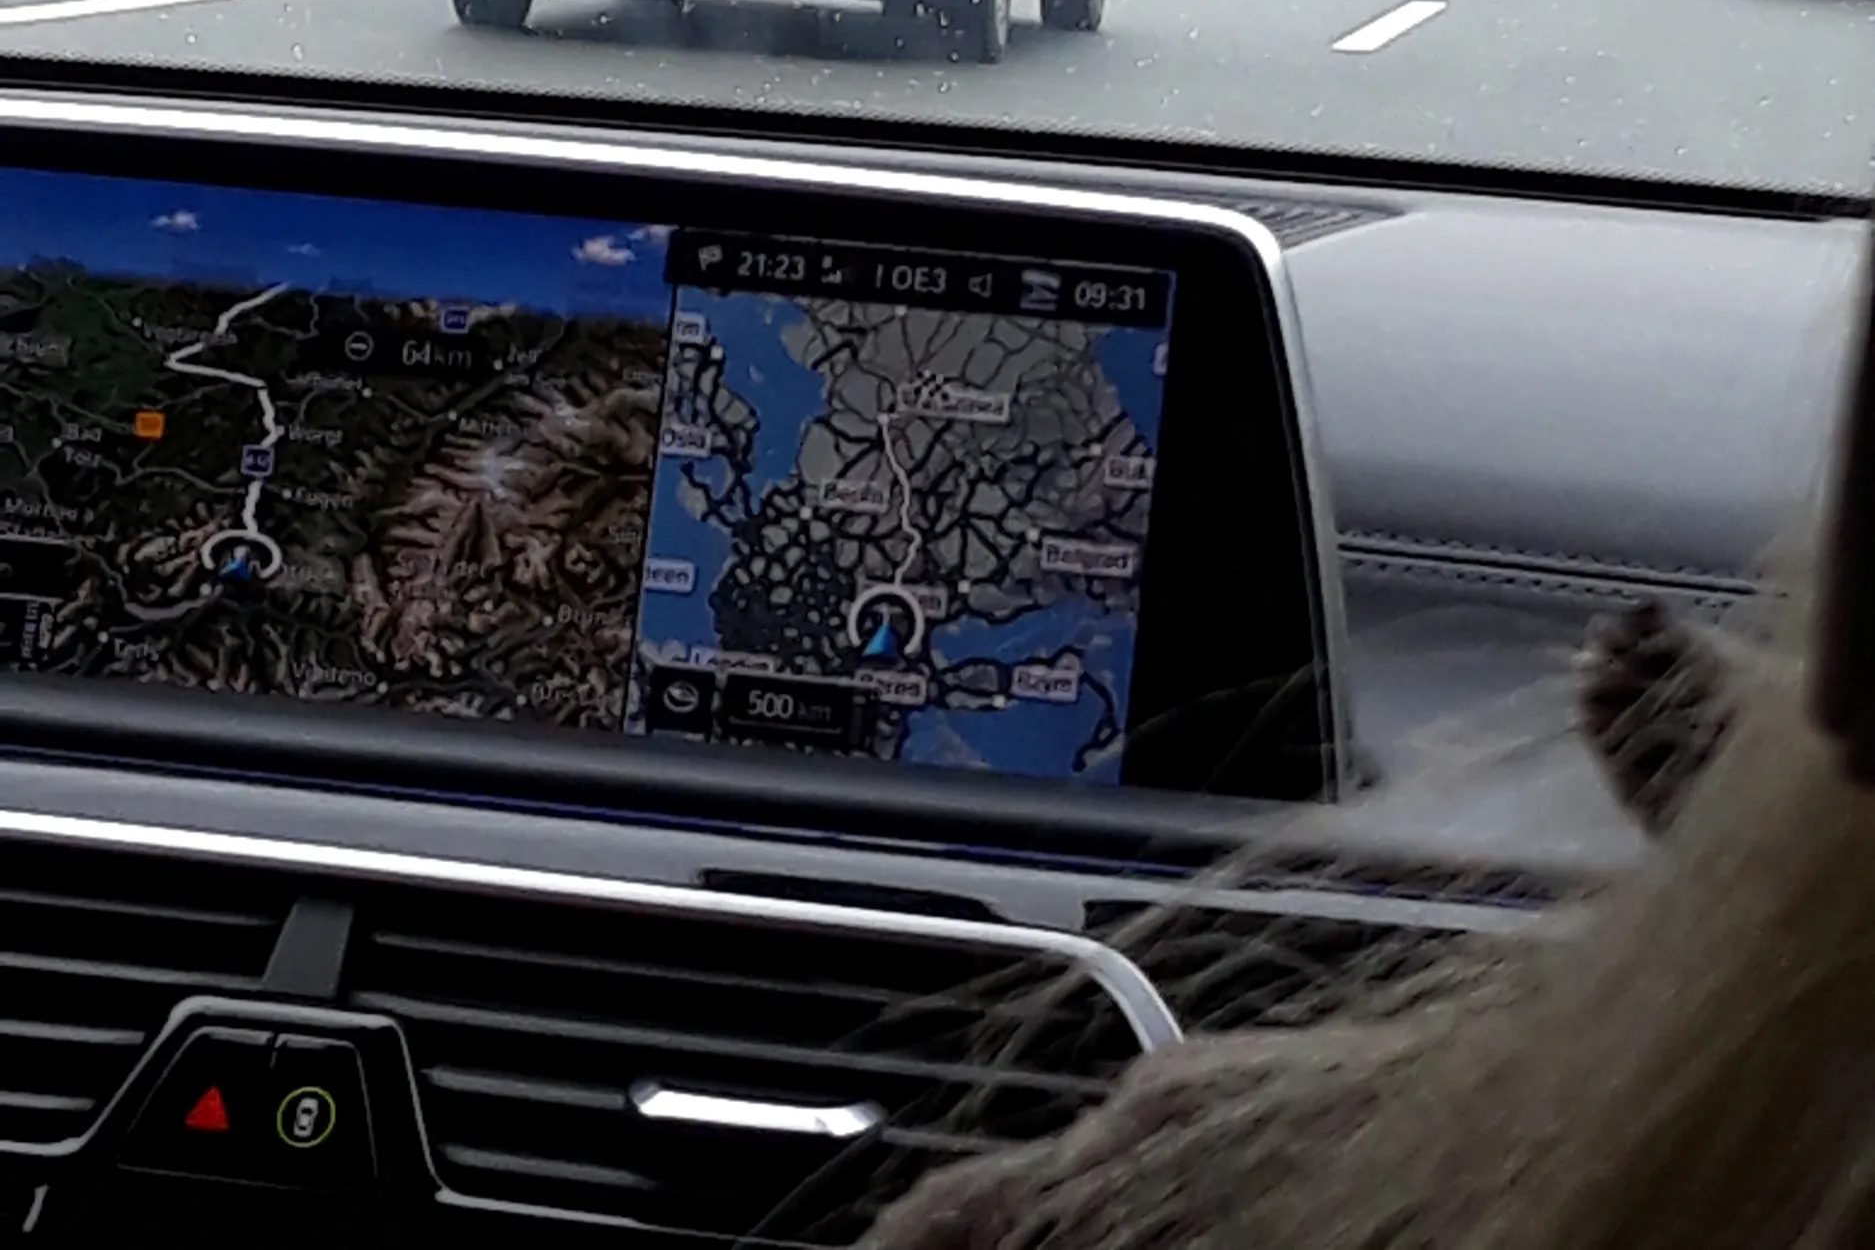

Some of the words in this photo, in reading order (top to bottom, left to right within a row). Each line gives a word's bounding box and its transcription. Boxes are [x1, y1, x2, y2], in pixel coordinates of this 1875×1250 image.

[736, 249, 807, 281] 21:23
[1073, 278, 1146, 311] 09:31
[746, 688, 794, 720] 500
